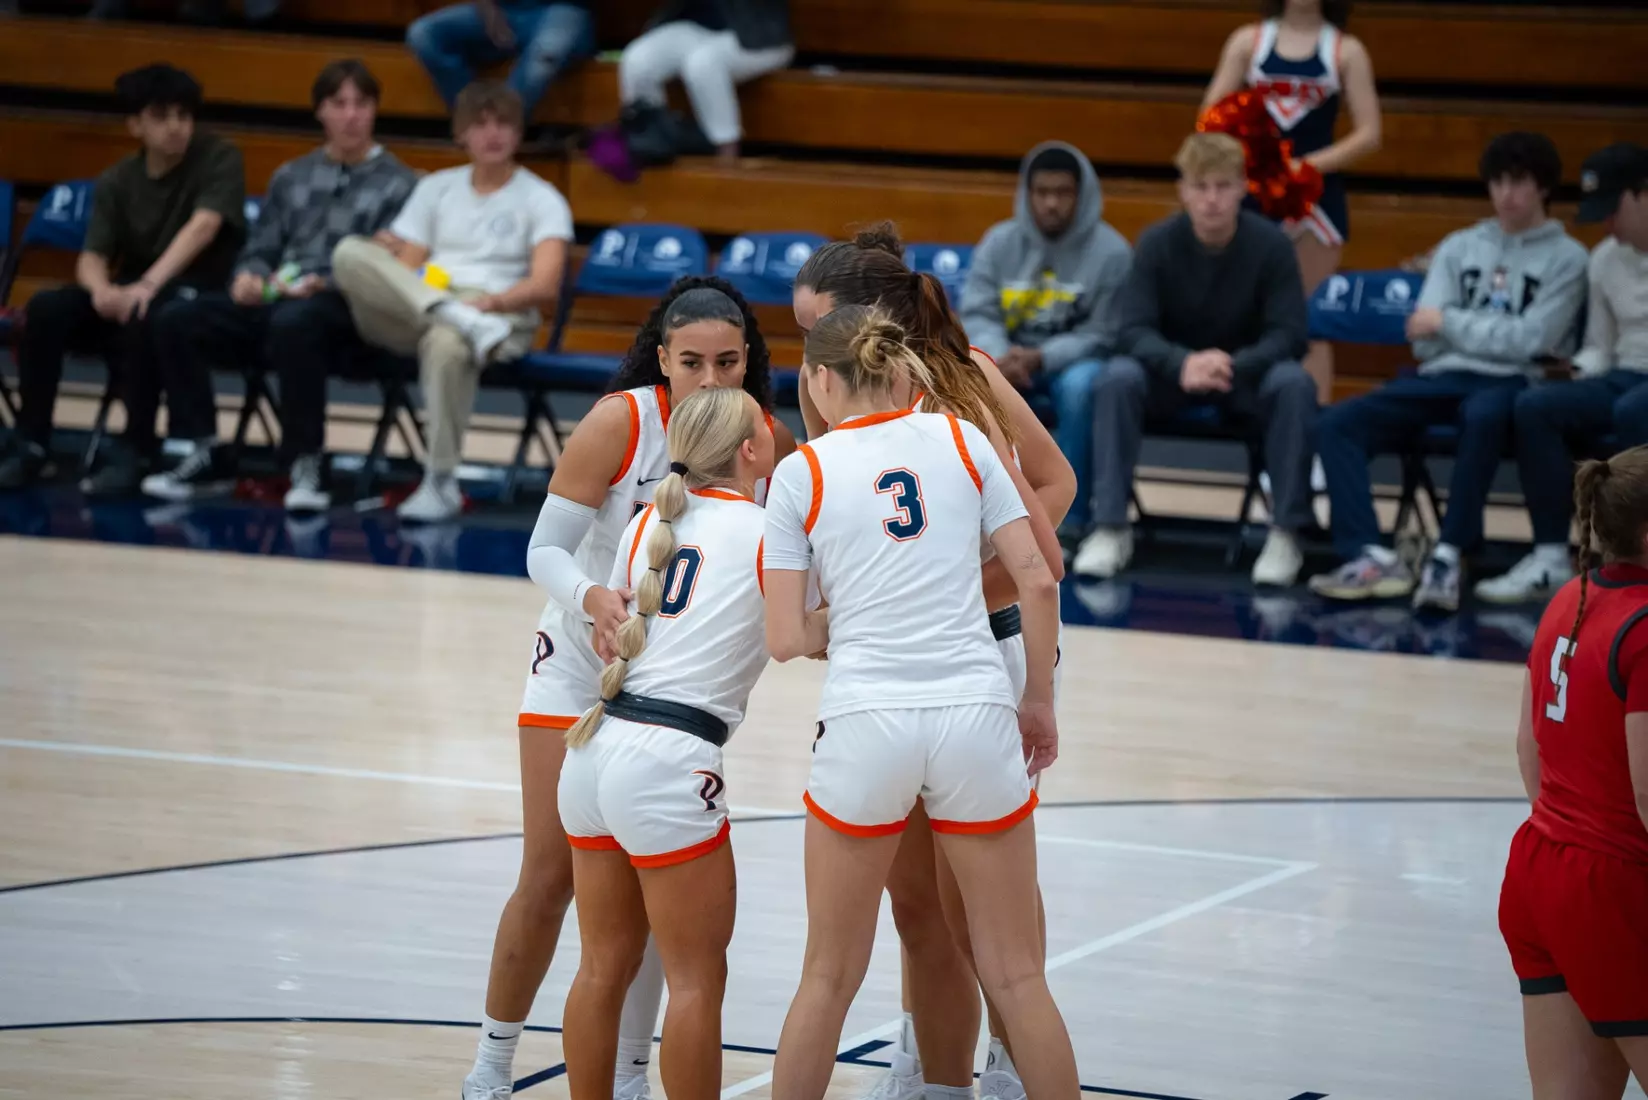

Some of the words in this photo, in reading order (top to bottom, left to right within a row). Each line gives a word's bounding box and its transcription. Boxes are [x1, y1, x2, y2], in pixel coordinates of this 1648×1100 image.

[1325, 275, 1350, 304] P
[873, 467, 928, 542] 3
[658, 544, 704, 618] 0
[532, 630, 554, 674] P
[1545, 635, 1578, 723] 5
[690, 769, 724, 812] P
